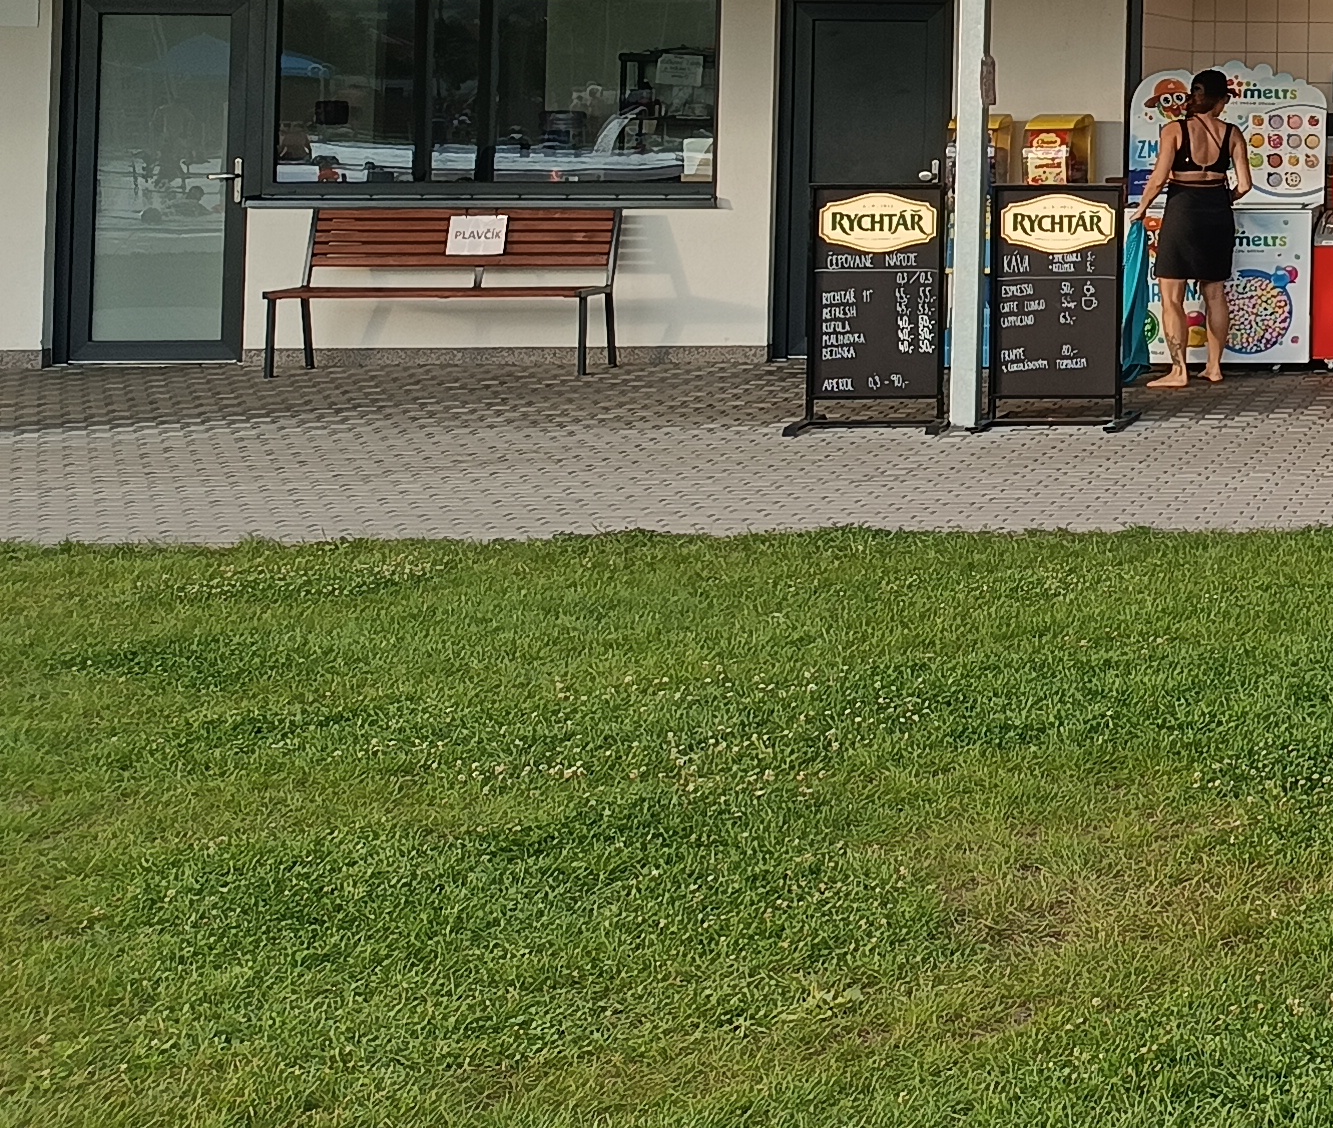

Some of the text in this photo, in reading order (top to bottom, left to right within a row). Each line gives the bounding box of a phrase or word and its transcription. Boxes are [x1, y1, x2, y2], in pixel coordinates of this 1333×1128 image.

[454, 228, 502, 240] PLAVČÍK
[831, 209, 929, 236] RYCHTÁŘ
[1012, 210, 1109, 237] RYCHTÁŘ
[885, 251, 918, 267] NÁPOJE
[1003, 250, 1030, 273] KÁVA
